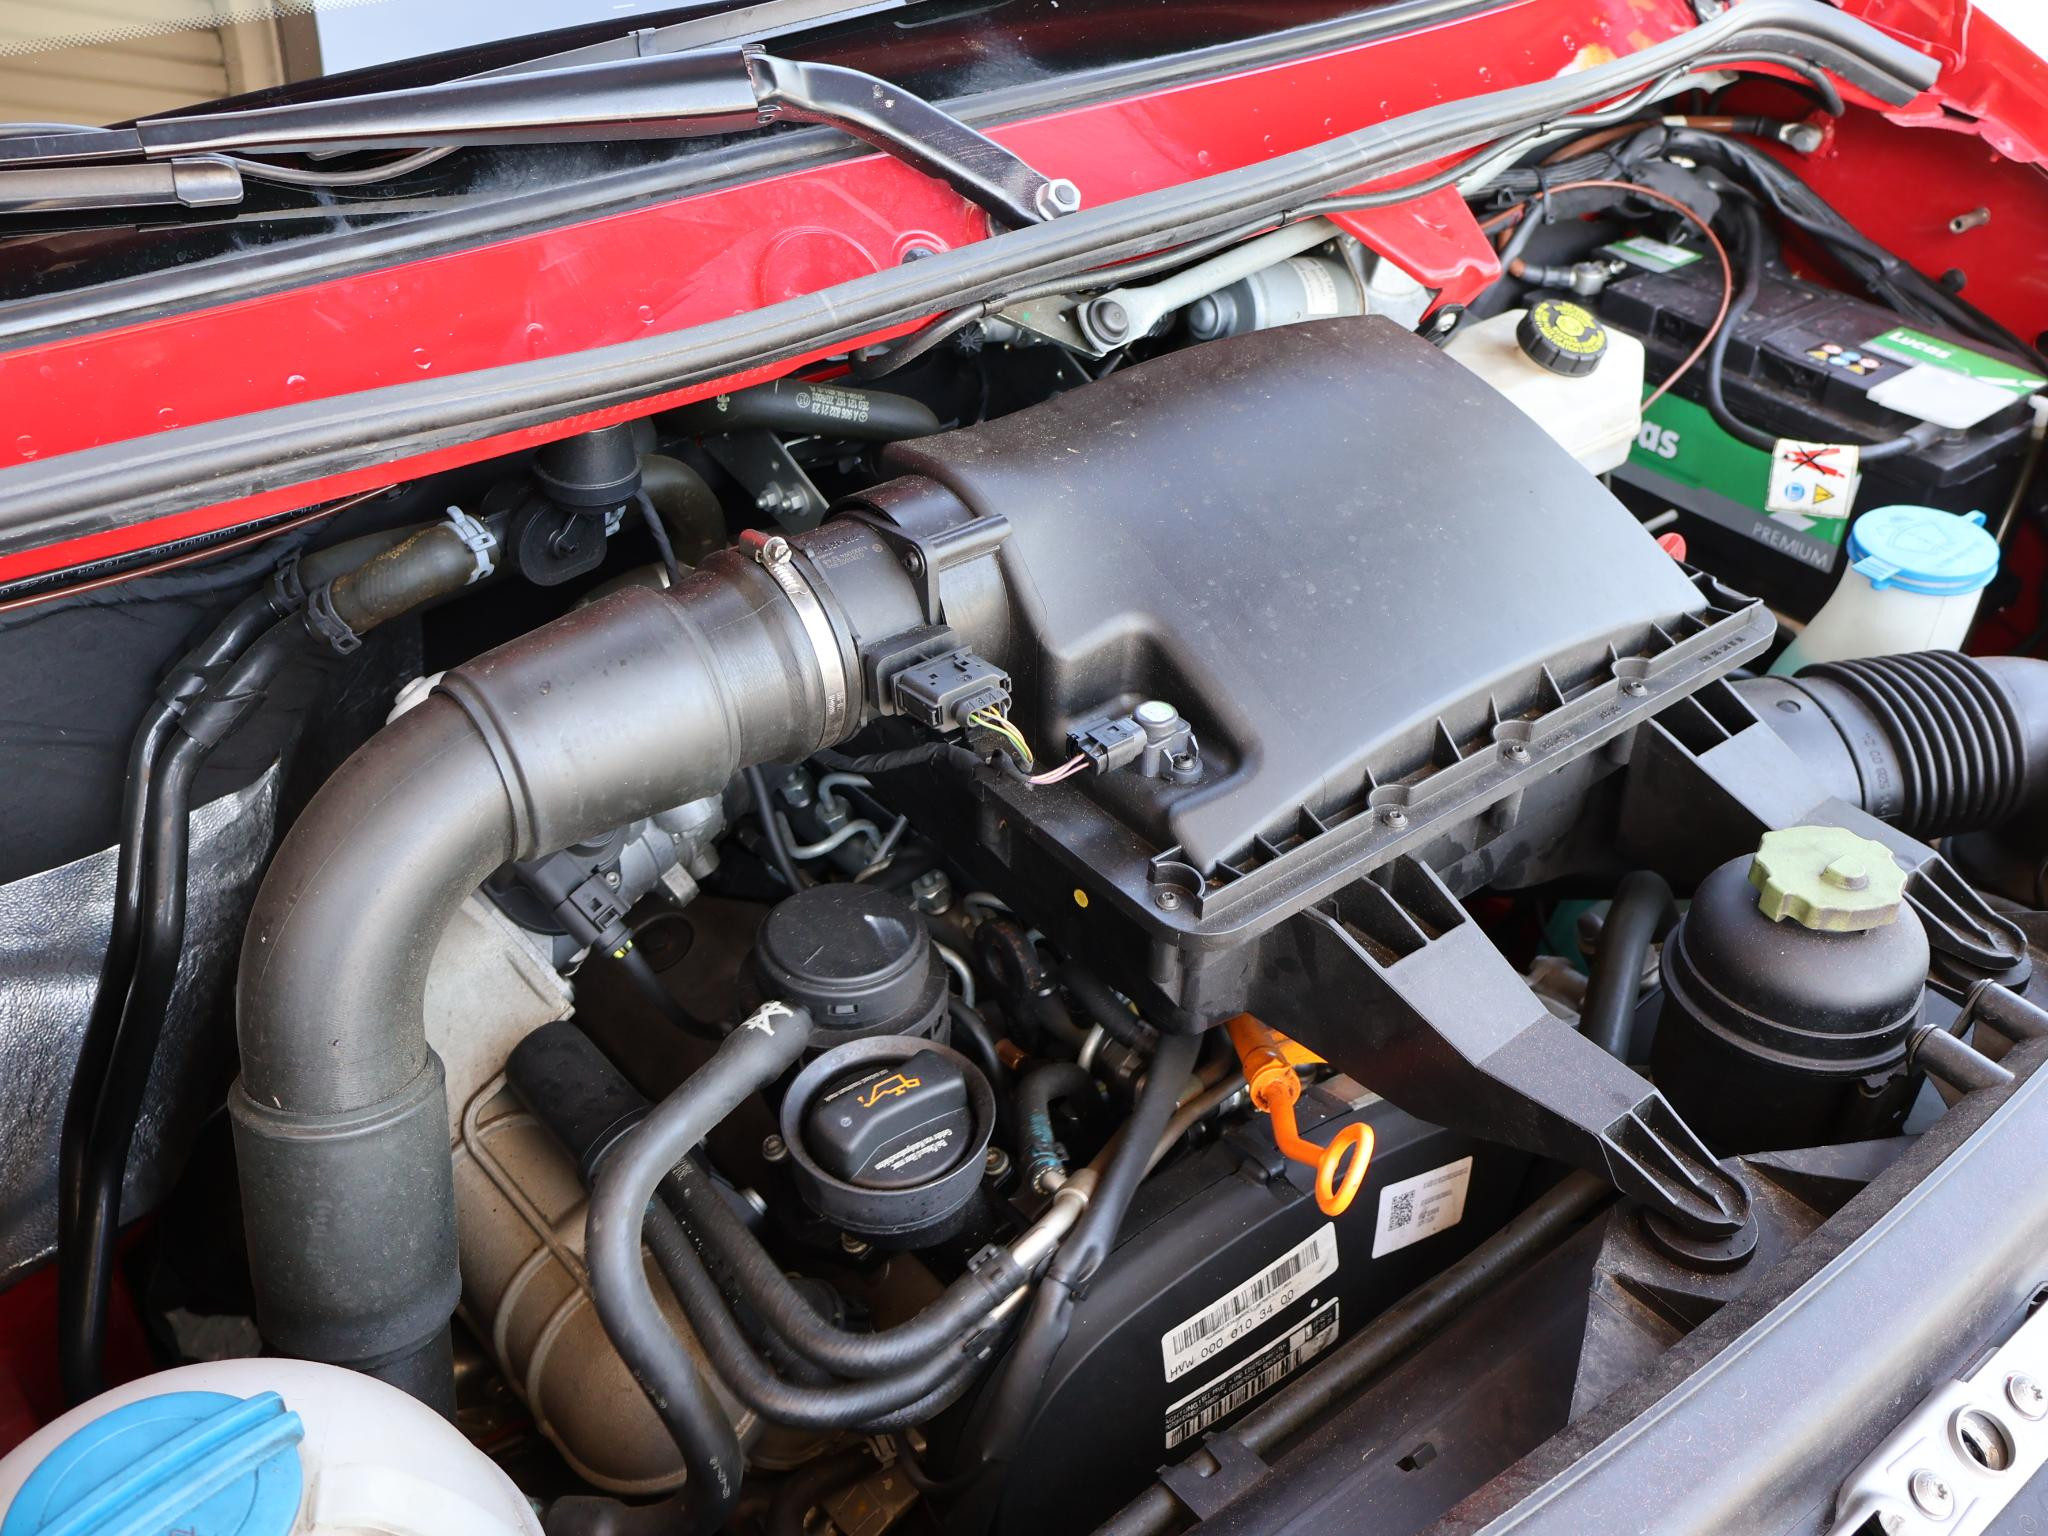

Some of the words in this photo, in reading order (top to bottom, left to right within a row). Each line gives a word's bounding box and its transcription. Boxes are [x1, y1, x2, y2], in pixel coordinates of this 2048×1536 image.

[1888, 332, 1952, 359] Lucas
[1632, 420, 1680, 459] as
[1752, 521, 1828, 568] PREMIUM
[1170, 1356, 1194, 1378] HVW
[1201, 1338, 1224, 1358] 000
[1259, 1304, 1273, 1320] 34
[1280, 1289, 1294, 1305] 00
